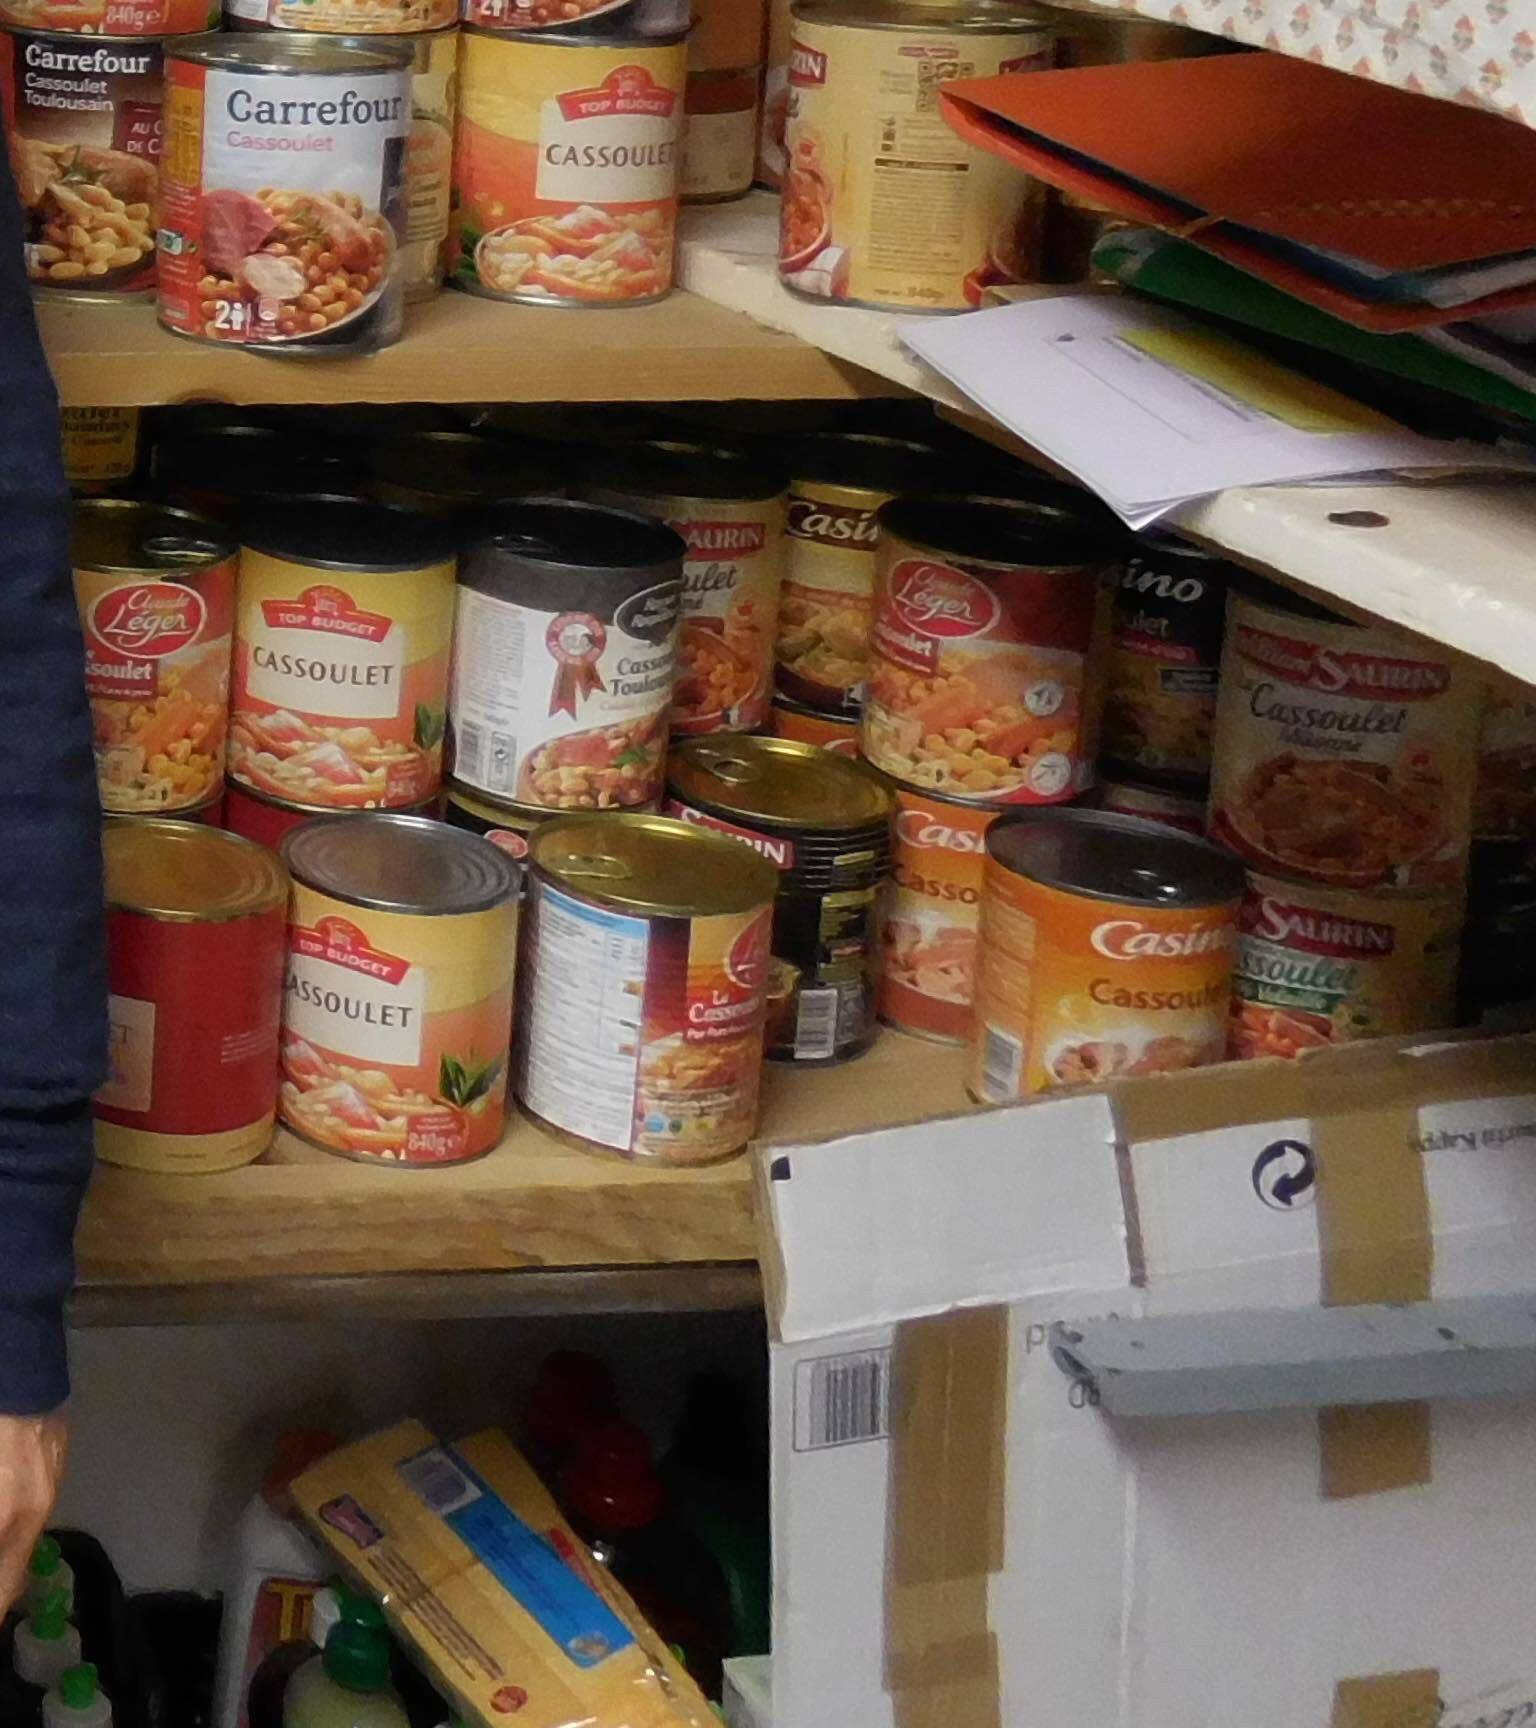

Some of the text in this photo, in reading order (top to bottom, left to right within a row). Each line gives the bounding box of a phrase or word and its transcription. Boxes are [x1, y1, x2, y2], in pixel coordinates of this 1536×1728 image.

[25, 43, 151, 74] Carrefour
[24, 71, 108, 94] Cassoulet
[23, 88, 115, 112] Toulousain
[226, 88, 403, 126] Carrefour
[578, 100, 611, 116] TOP
[225, 130, 336, 153] Cassoulet
[545, 140, 674, 168] CASSOULET
[214, 302, 231, 330] 2
[687, 527, 761, 549] AURIN
[788, 502, 880, 543] Casi
[1120, 558, 1204, 603] ino
[103, 604, 189, 648] Léger
[277, 612, 378, 637] TOP BUDGET
[252, 645, 395, 686] CASSOULET
[1249, 682, 1408, 734] Cassoulet
[896, 809, 986, 856] Casi
[1090, 919, 1227, 961] Casin
[327, 949, 394, 977] BUDGET
[285, 976, 414, 1029] ASSOULET
